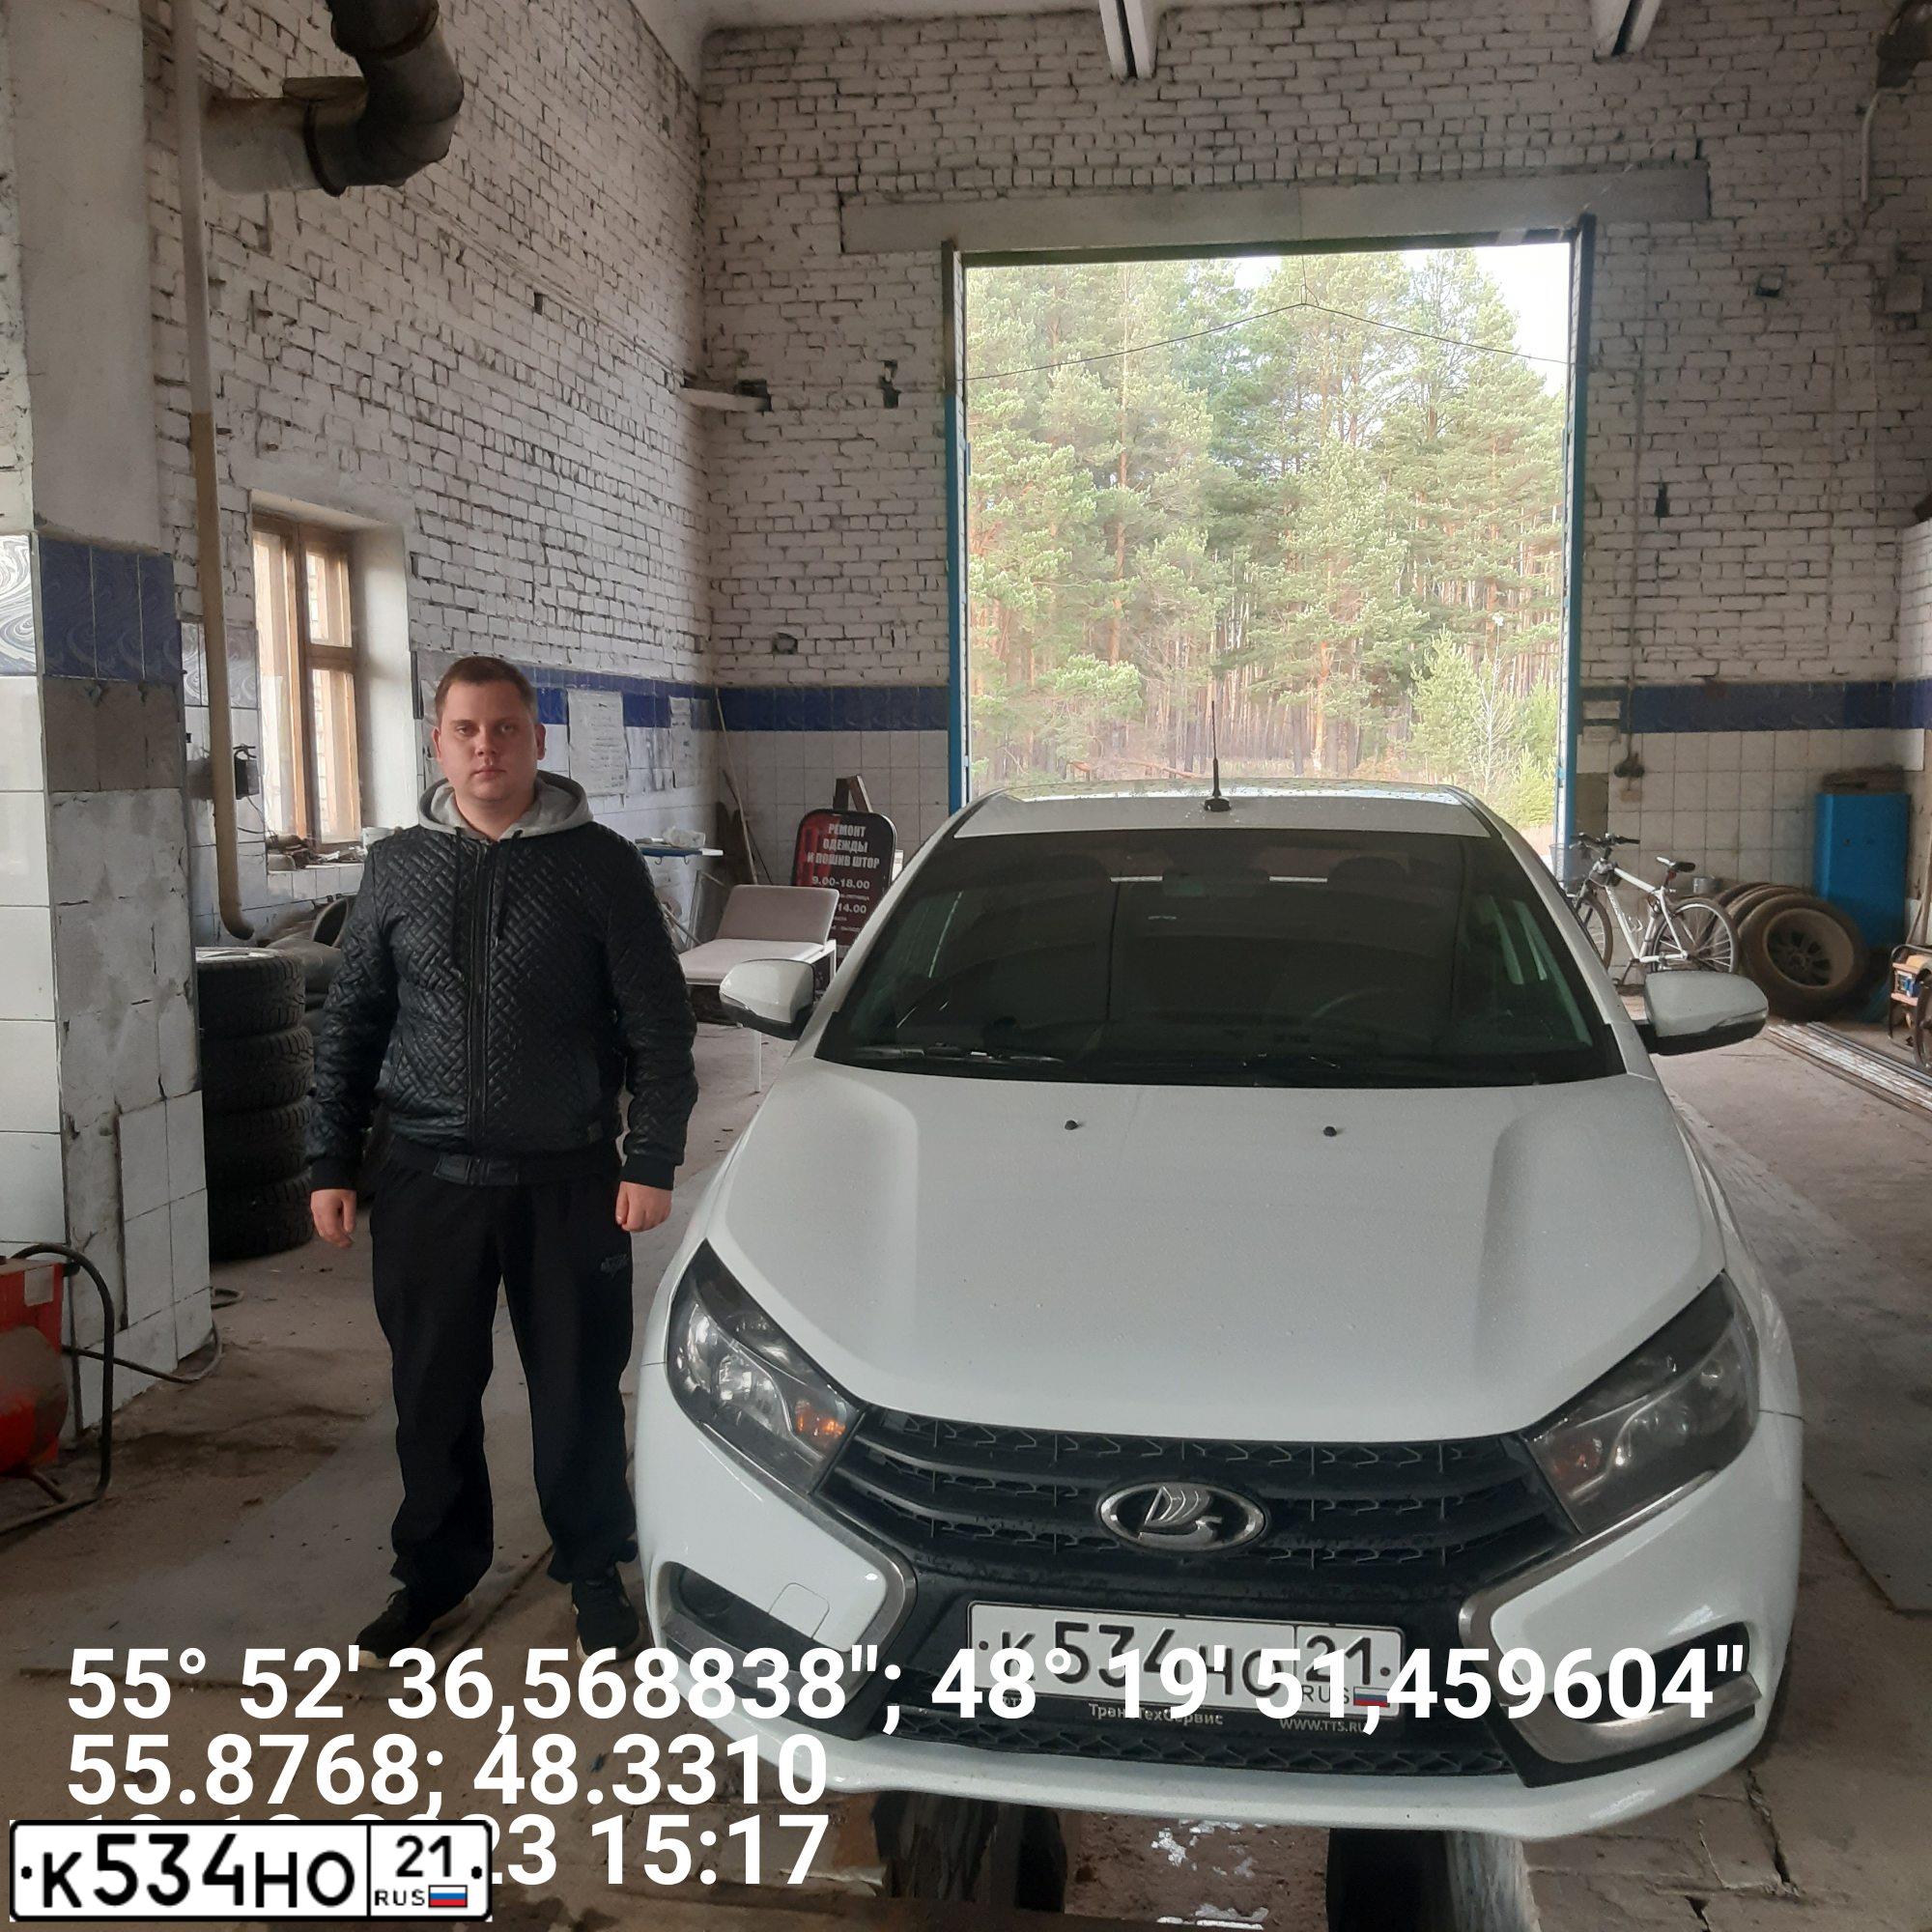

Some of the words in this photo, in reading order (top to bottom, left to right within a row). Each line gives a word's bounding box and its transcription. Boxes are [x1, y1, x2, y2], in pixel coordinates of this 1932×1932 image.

[829, 823, 867, 838] РЕМОНТ
[823, 838, 868, 854] ОДЕЖДЫ
[808, 852, 814, 863] И
[815, 853, 851, 867] ПОШИВ
[852, 856, 880, 868] ШТОР
[1306, 1634, 1372, 1685] 21
